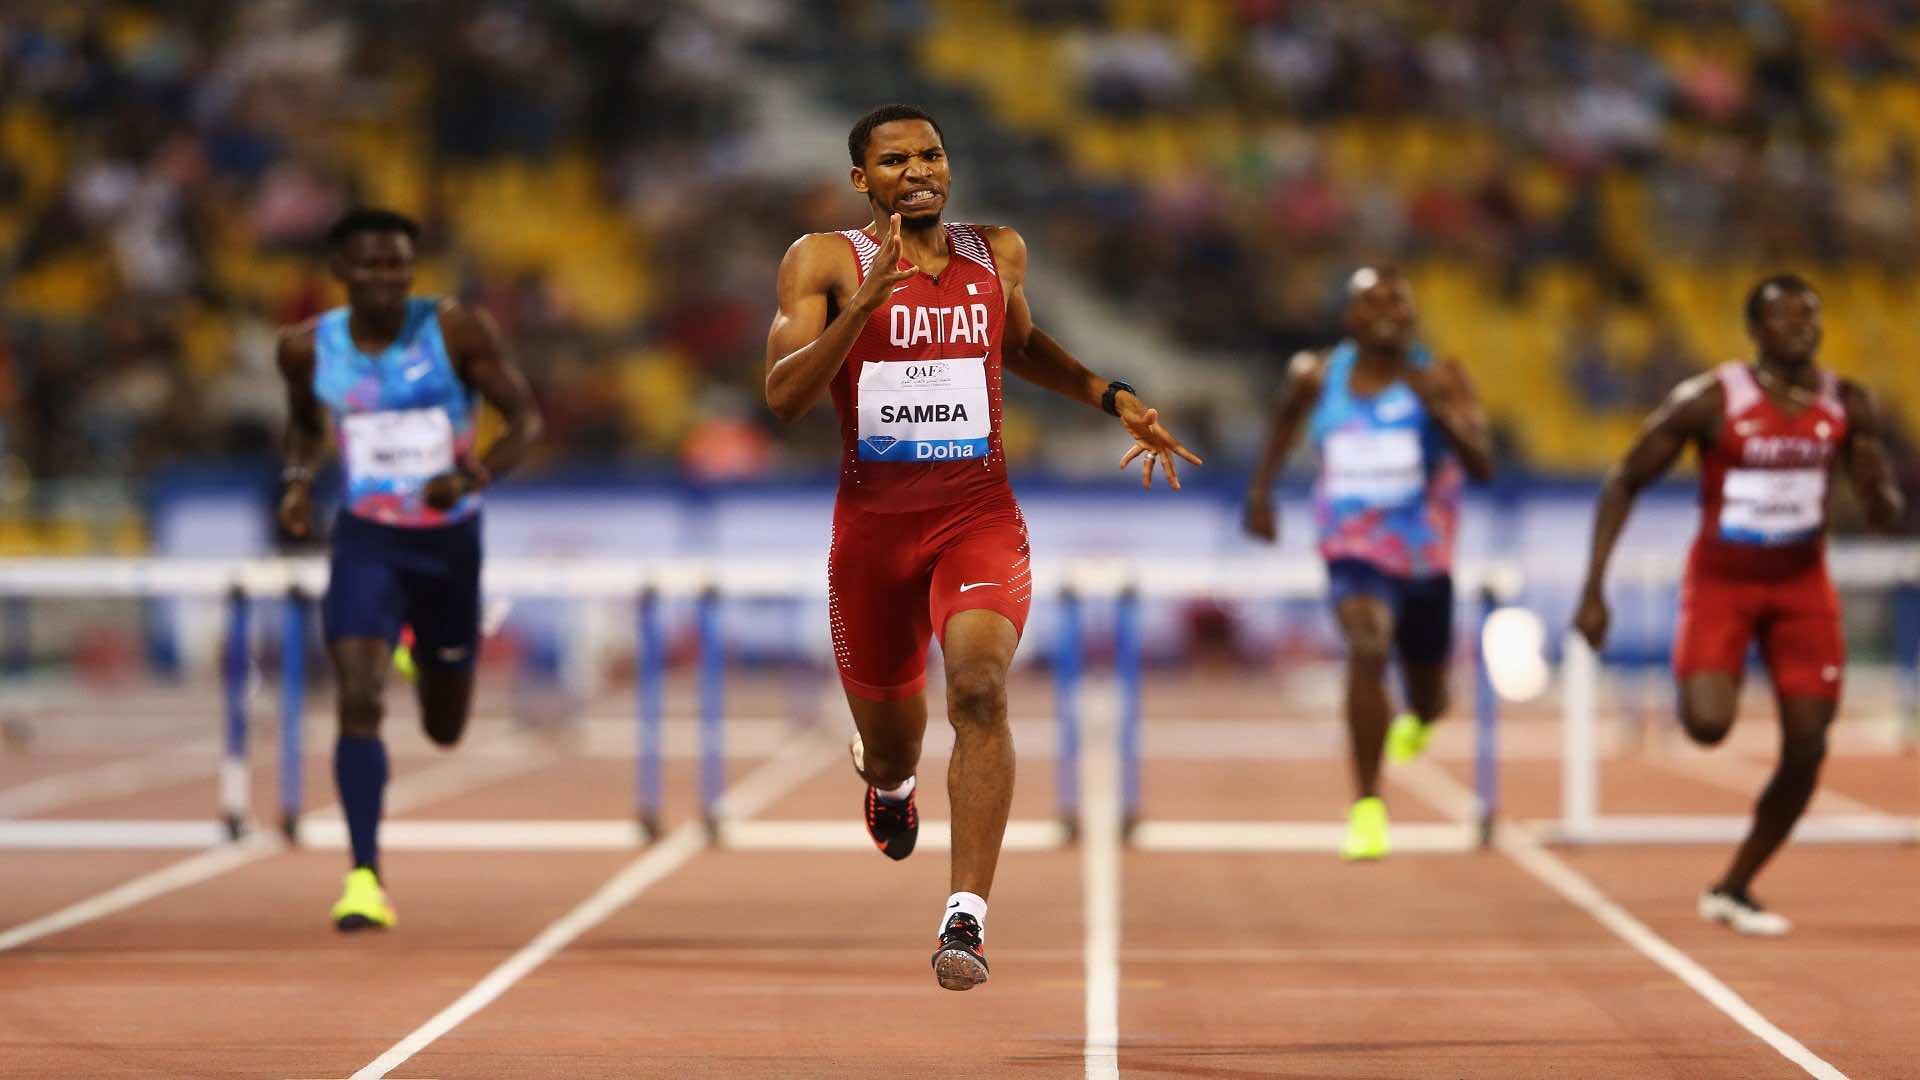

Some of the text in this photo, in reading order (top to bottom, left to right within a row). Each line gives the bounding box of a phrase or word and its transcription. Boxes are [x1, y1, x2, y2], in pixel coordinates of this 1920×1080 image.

[890, 303, 989, 348] QATAR
[880, 403, 968, 423] SAMBA
[916, 441, 973, 459] Doha
